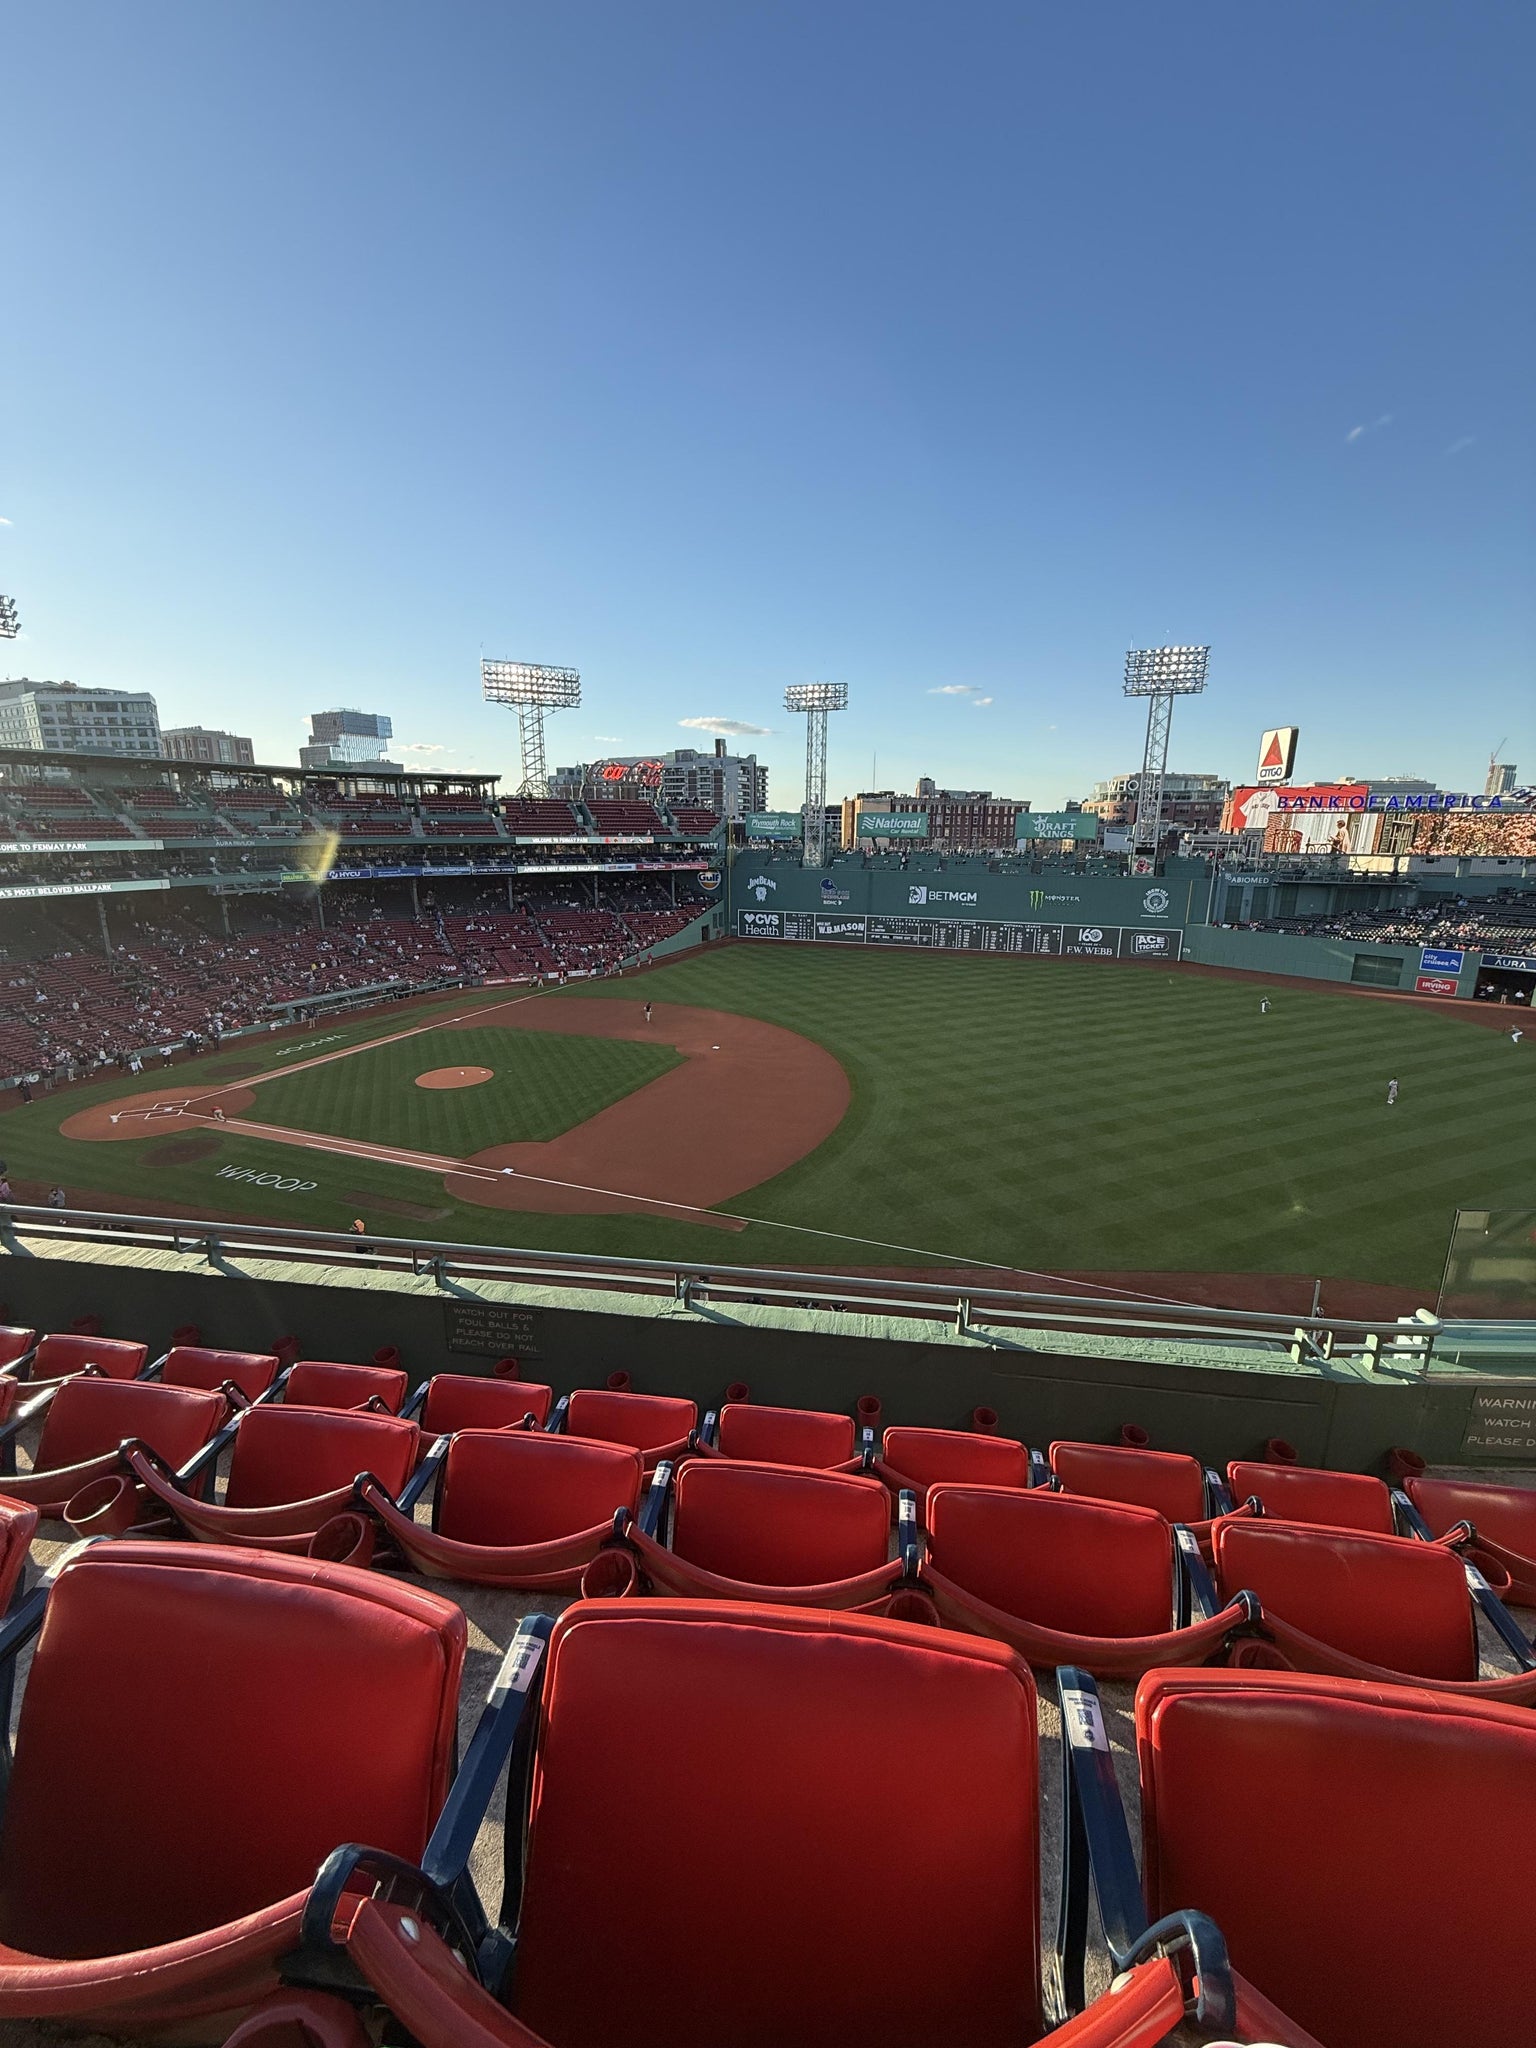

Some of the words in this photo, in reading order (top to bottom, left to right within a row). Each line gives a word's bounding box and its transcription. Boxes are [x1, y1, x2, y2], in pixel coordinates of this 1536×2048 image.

[1260, 767, 1282, 777] CITGO
[1278, 796, 1341, 808] BANK
[1350, 795, 1380, 808] OF
[1386, 795, 1502, 808] AMERICA
[780, 818, 796, 827] Rock
[875, 818, 921, 829] National
[1034, 822, 1077, 832] DRAFT
[1039, 830, 1075, 838] KINGS
[700, 873, 720, 881] Gulf
[14, 888, 36, 896] MOST
[38, 886, 73, 894] BELOVED
[74, 884, 112, 892] BALLPARK
[928, 890, 977, 902] BETMGM
[1045, 894, 1080, 902] MONSTER
[755, 914, 779, 925] CVS
[745, 924, 779, 936] Health
[1079, 928, 1103, 942] 160
[1138, 935, 1165, 944] ACE
[1085, 946, 1112, 956] WEBB
[1423, 959, 1449, 967] cruises
[1422, 981, 1451, 990] IRVING
[215, 1164, 318, 1192] WHOOP
[453, 1307, 485, 1317] WATCH
[488, 1310, 509, 1320] OUT
[512, 1313, 534, 1321] FOR
[459, 1318, 484, 1327] FOUL
[488, 1321, 519, 1331] BALLS
[522, 1323, 530, 1331] &
[456, 1328, 492, 1338] PLEASE
[496, 1331, 511, 1340] DO
[514, 1334, 534, 1342] NOT
[452, 1337, 485, 1347] REACH
[487, 1341, 515, 1350] OVER
[1484, 1418, 1532, 1428] WATCH
[1467, 1435, 1522, 1446] PLEASE
